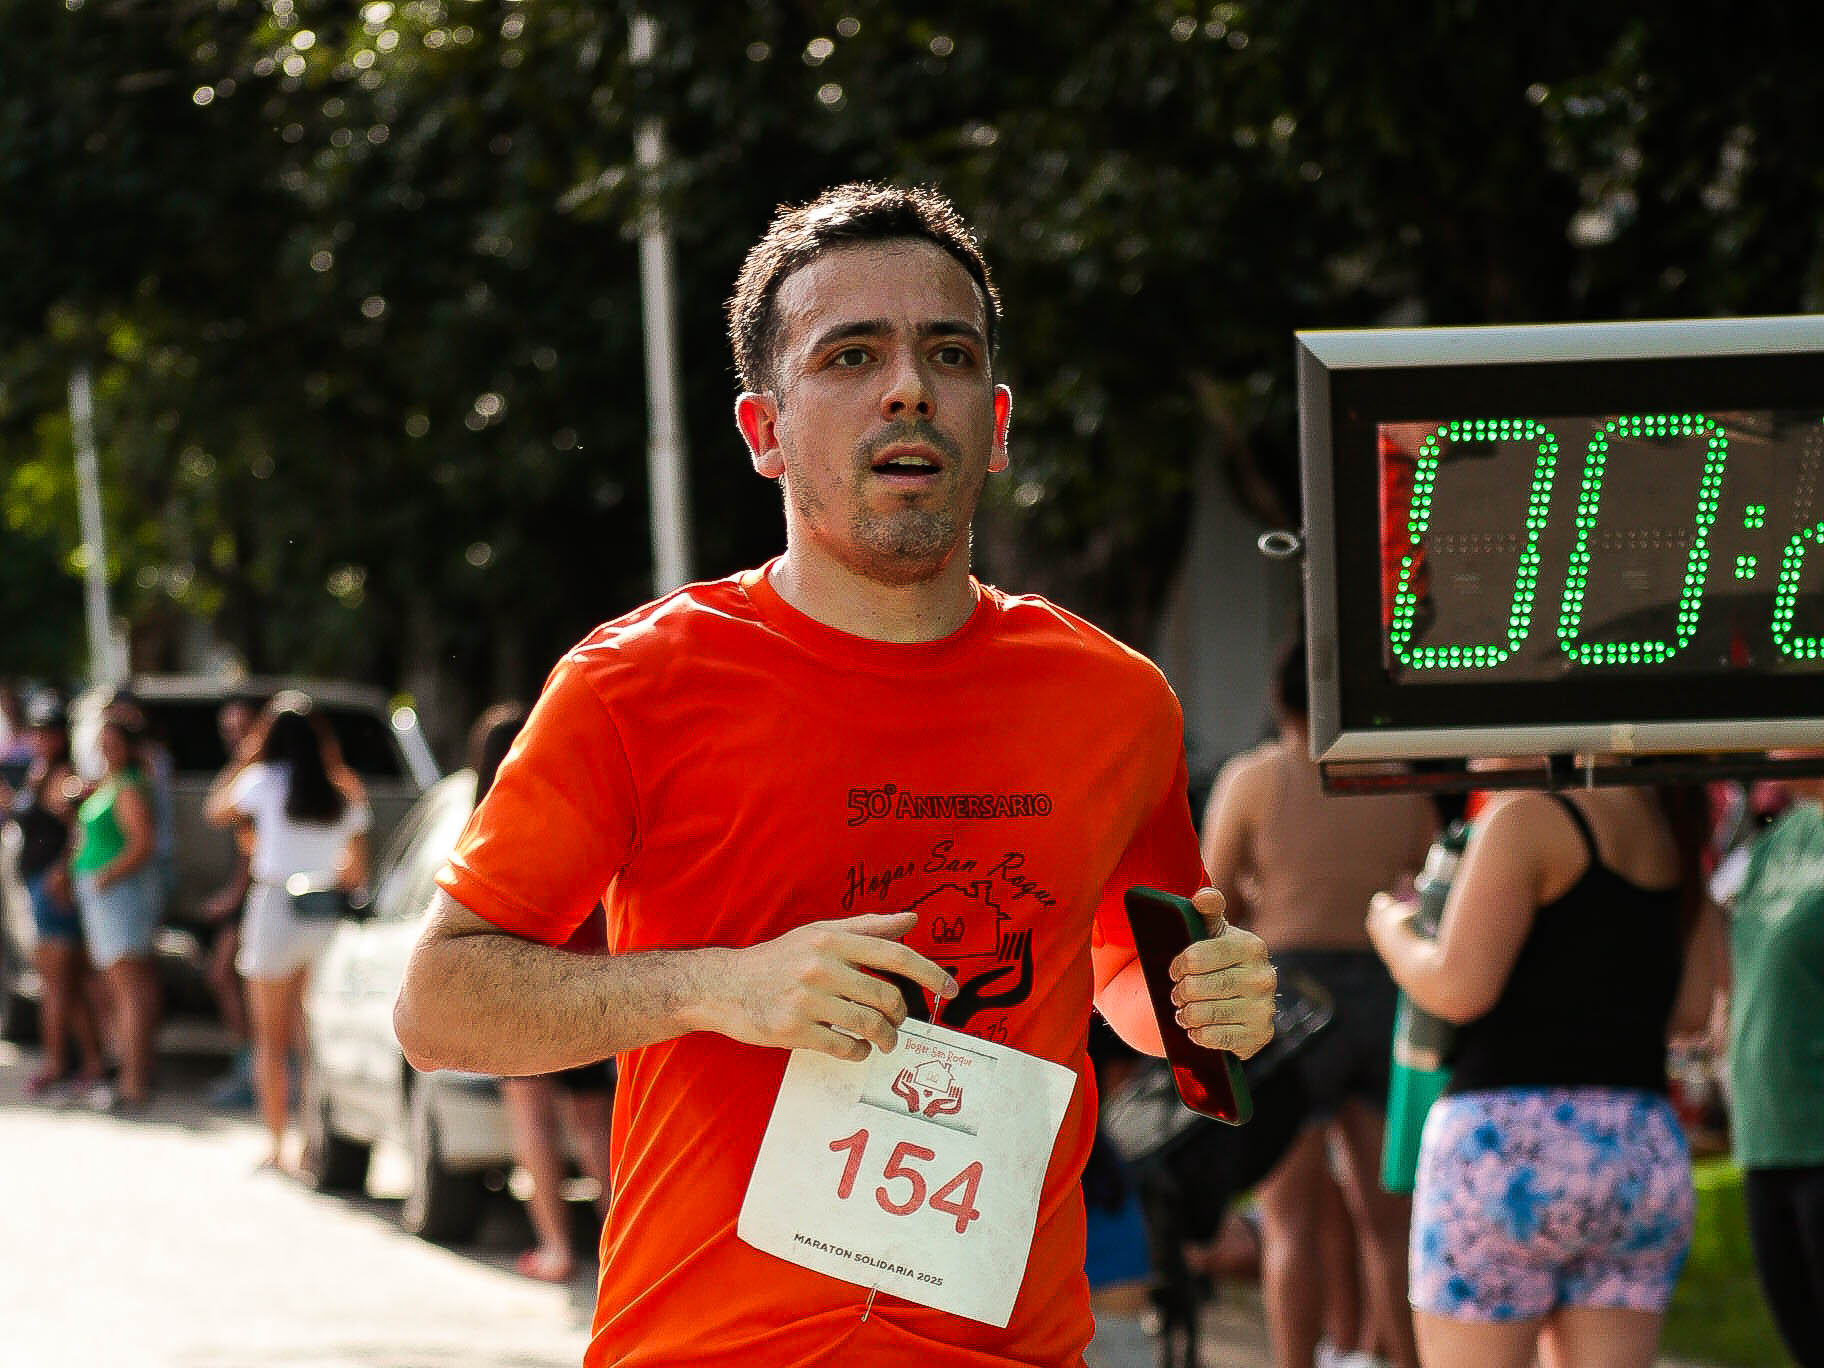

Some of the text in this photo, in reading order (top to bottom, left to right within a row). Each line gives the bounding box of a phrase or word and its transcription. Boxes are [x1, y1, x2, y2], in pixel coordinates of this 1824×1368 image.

[841, 860, 915, 911] Hogar
[923, 839, 977, 873] San
[829, 1129, 984, 1234] 154
[793, 1233, 944, 1287] MARATON SOLIDARIA 2025
